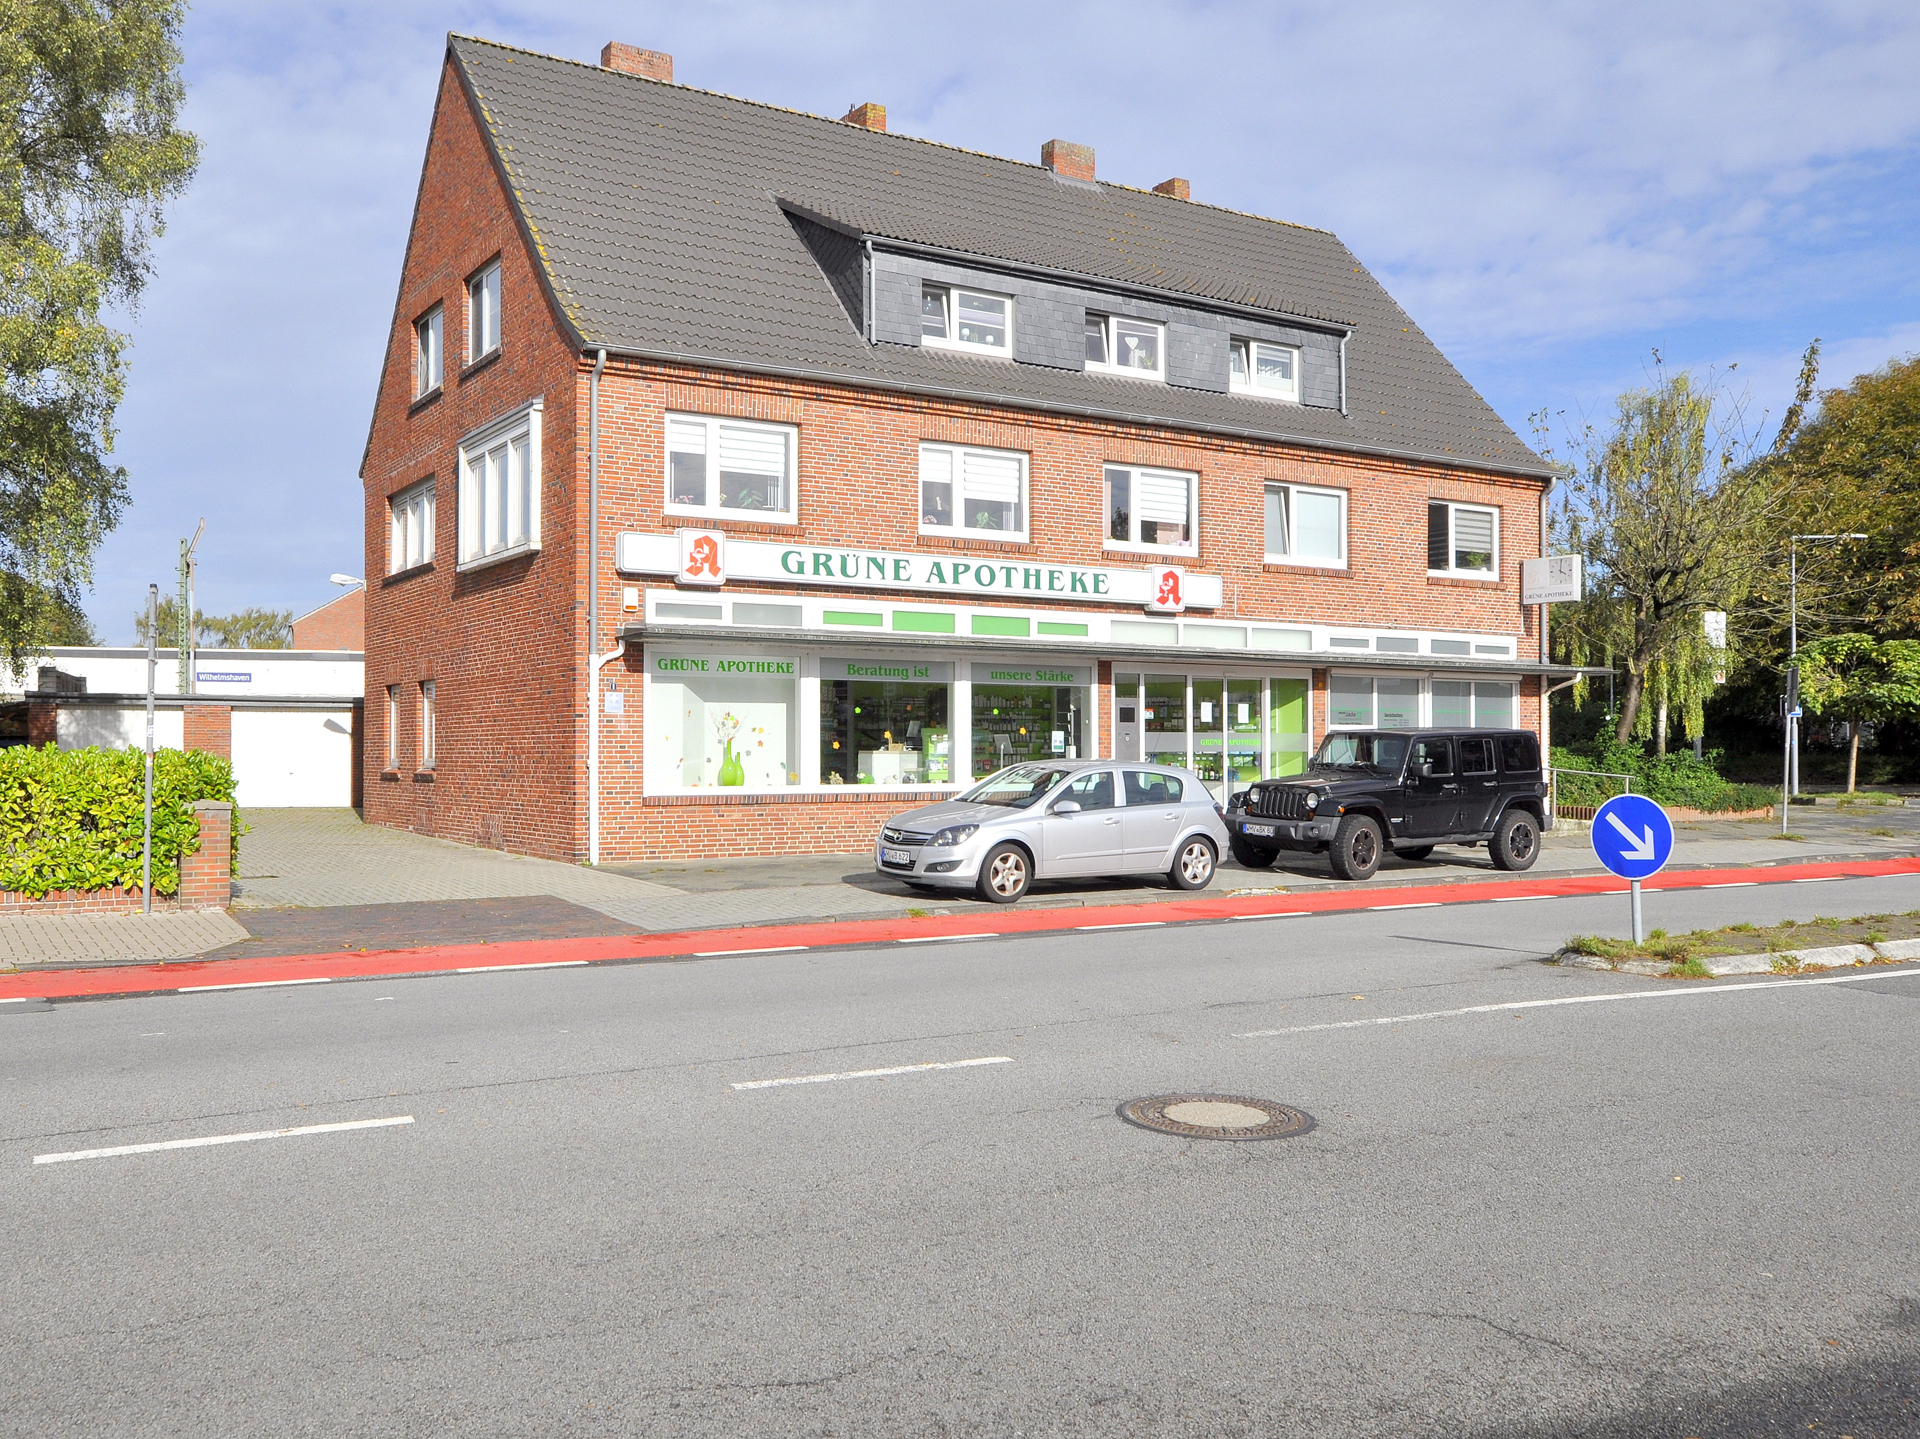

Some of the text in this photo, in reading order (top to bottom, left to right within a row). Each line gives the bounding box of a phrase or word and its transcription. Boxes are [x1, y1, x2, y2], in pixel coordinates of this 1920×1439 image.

[781, 550, 1111, 595] GRÜNE APOTHEKE
[1525, 590, 1573, 600] GRÜNE APOTHEKE
[657, 658, 795, 674] GRÜNE APOTHEKE
[847, 664, 930, 679] Beratung ist
[199, 673, 250, 681] Wilhelmshaven
[991, 670, 1074, 682] unsere Stärke
